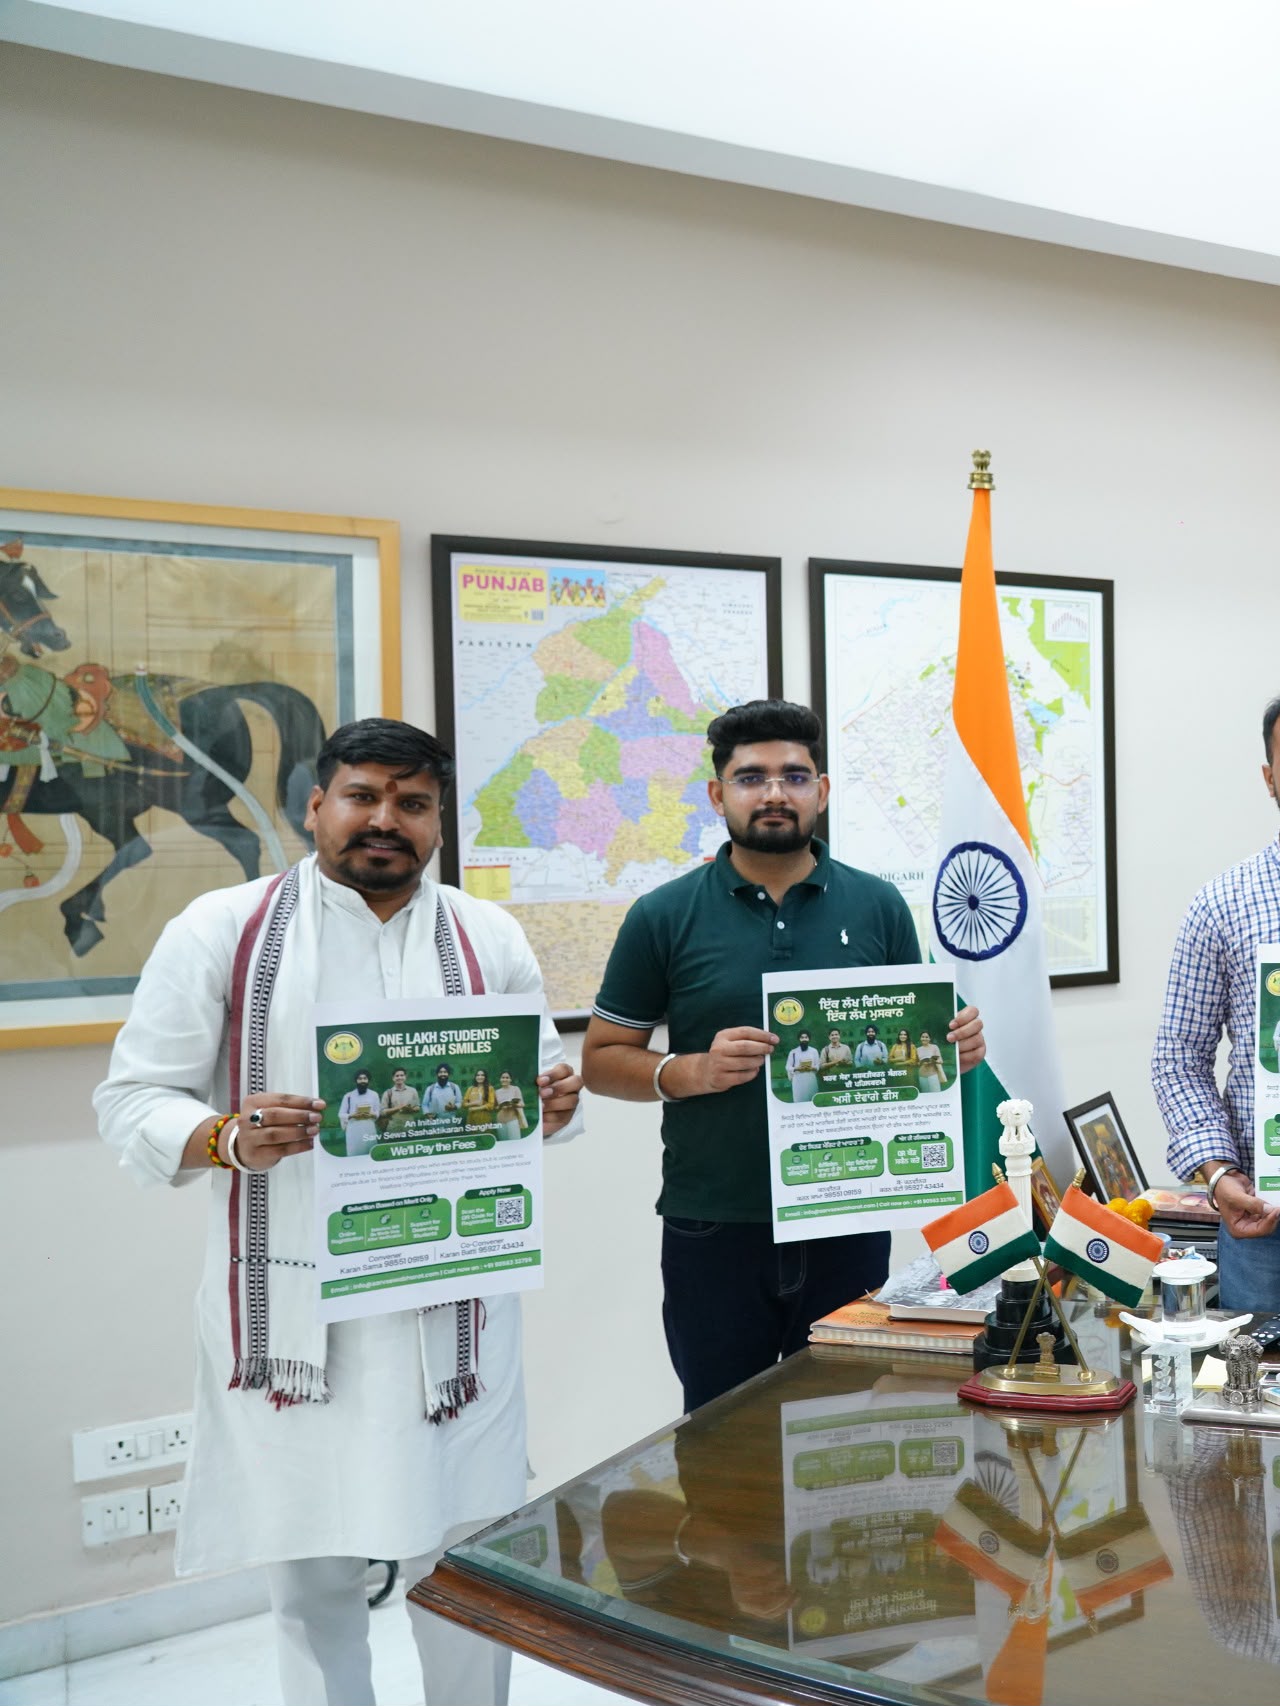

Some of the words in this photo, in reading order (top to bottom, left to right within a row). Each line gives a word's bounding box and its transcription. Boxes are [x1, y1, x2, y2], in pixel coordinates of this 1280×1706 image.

[463, 574, 544, 592] PUNJAB
[880, 871, 924, 880] DIGARH
[818, 997, 840, 1010] ਇੱਕ
[841, 997, 860, 1008] ਲੱਖ
[826, 1009, 847, 1022] ਇੱਕ
[849, 1008, 867, 1020] ਲੱਖ
[869, 1008, 904, 1020] ਮੁਸਕਾਨ
[378, 1034, 403, 1046] ONE
[406, 1031, 437, 1045] LAKH
[440, 1028, 499, 1043] STUDENTS
[387, 1046, 412, 1059] ONE
[415, 1044, 446, 1057] LAKH
[448, 1041, 492, 1055] SMILES
[405, 1120, 416, 1128] An
[418, 1118, 450, 1127] Initiative
[452, 1116, 463, 1124] by
[383, 1131, 406, 1140] Sewa
[408, 1126, 464, 1138] Sashaktikaran
[465, 1123, 502, 1133] Sanghtan
[391, 1145, 414, 1156] We'll
[416, 1144, 435, 1155] Pay
[435, 1142, 451, 1152] the
[452, 1140, 476, 1150] Fees
[440, 1251, 460, 1259] Karan
[479, 1245, 500, 1253] 95927
[501, 1242, 524, 1250] 43434
[460, 1239, 504, 1249] Co-Convener
[340, 1266, 361, 1274] Karan
[363, 1263, 383, 1271] Sama
[384, 1258, 406, 1267] 98551
[408, 1254, 429, 1264] 09159
[368, 1253, 402, 1263] Convener
